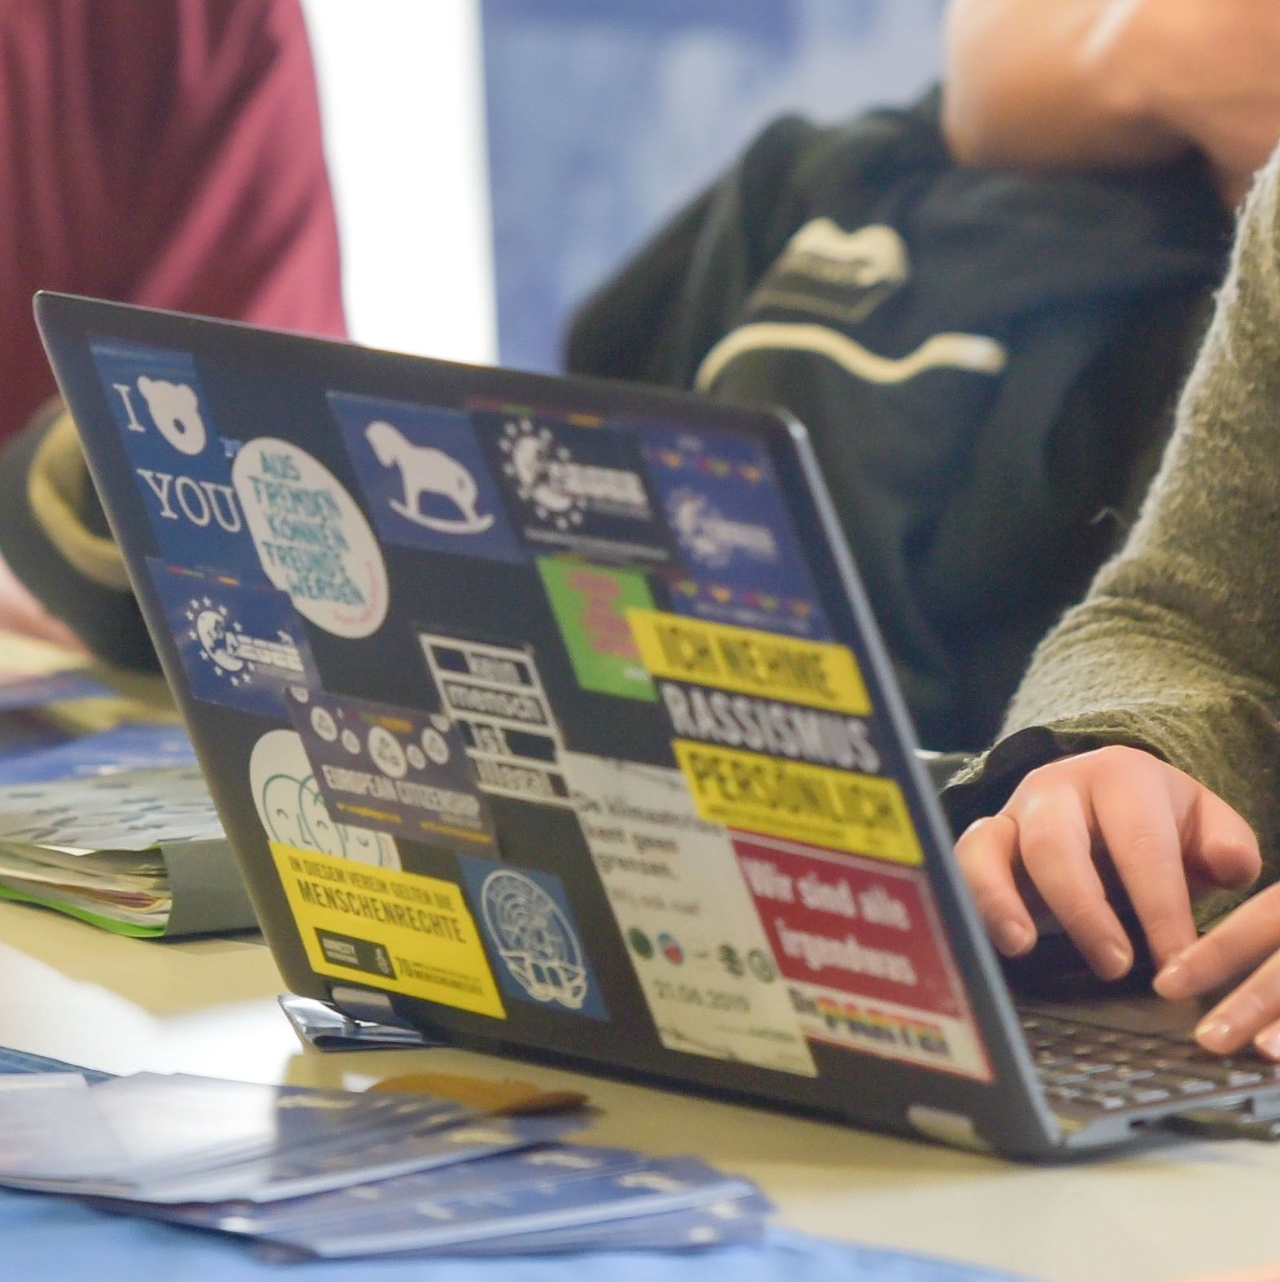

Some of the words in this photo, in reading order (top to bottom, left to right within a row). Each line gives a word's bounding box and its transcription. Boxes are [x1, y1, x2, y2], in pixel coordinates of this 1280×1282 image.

[113, 383, 145, 433] I
[137, 468, 243, 533] YOU
[655, 623, 710, 676] ICH
[713, 634, 834, 698] NEHME
[446, 680, 545, 725] mensch
[662, 684, 880, 772] RASSISMUS
[474, 719, 508, 756] ist
[321, 763, 397, 804] EUROPEAN
[398, 780, 482, 816] CITIZENSHIP
[686, 747, 902, 828] PERSÖNLICH
[303, 858, 346, 885] DIESEM
[345, 870, 389, 895] VEREIN
[741, 856, 794, 905] Wir
[797, 871, 857, 919] sind
[858, 884, 912, 932] alle
[297, 878, 467, 945] MENSCHENRECHTE
[774, 917, 919, 988] irgendwas
